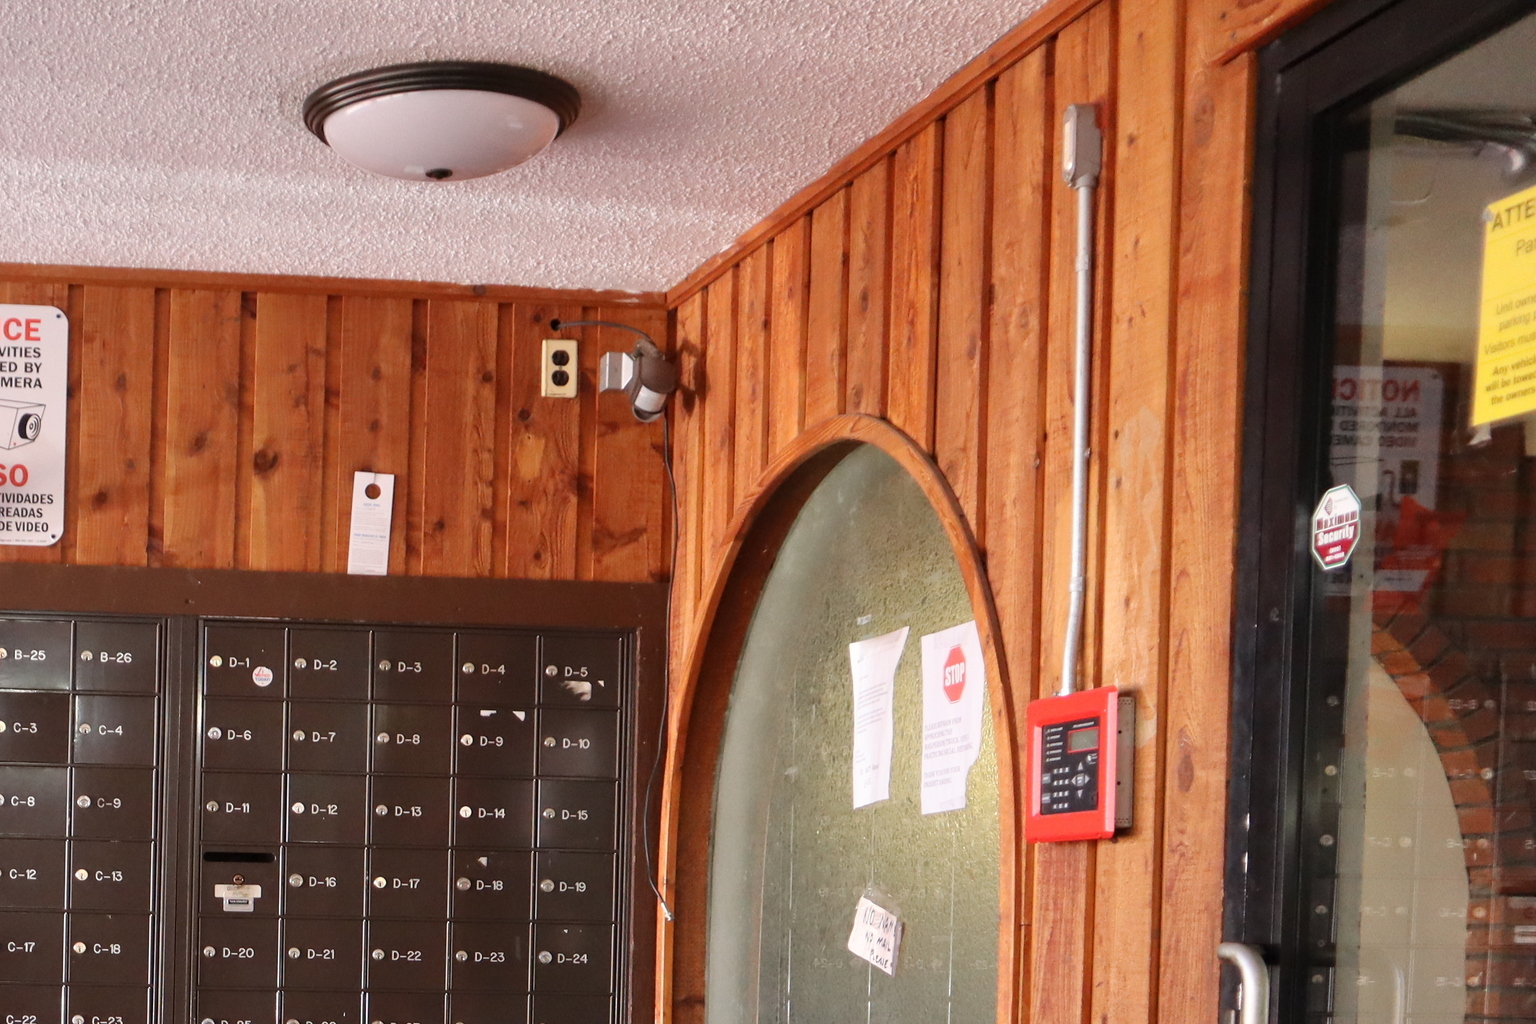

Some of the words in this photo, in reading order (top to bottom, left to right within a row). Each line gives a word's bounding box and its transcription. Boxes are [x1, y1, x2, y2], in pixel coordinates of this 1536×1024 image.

[1492, 197, 1536, 232] ATTE
[1516, 237, 1536, 257] Pa
[24, 362, 42, 373] BY
[15, 521, 49, 533] VIDEO
[1317, 525, 1355, 546] Security
[15, 650, 46, 660] B-25
[101, 652, 131, 663] B-26
[230, 657, 249, 667] D-1
[314, 660, 337, 670] D-2
[398, 662, 421, 672] D-3
[482, 664, 505, 674] D-4
[565, 667, 588, 677] D-5
[944, 662, 964, 686] STOP
[14, 723, 37, 733] C-3
[99, 725, 122, 735] C-4
[228, 730, 251, 740] D-6
[313, 732, 335, 742] D-7
[397, 734, 420, 744] D-8
[480, 736, 503, 746] D-9
[563, 738, 590, 749] D-10
[11, 796, 35, 806] C-8
[98, 798, 121, 808] C-9
[226, 803, 249, 812] D-11
[312, 804, 337, 814] D-12
[395, 806, 421, 816] D-13
[479, 808, 505, 818] D-14
[562, 810, 588, 820] D-15
[10, 869, 36, 879] C-12
[96, 871, 122, 881] C-13
[310, 877, 336, 887] D-16
[394, 879, 419, 888] D-17
[477, 880, 503, 890] D-18
[560, 882, 586, 892] D-19
[8, 942, 35, 952] C-17
[94, 944, 120, 954] C-18
[223, 948, 254, 958] D-20
[308, 949, 334, 959] D-21
[392, 951, 421, 961] D-22
[475, 952, 505, 962] D-23
[558, 954, 587, 963] D-24
[6, 1015, 37, 1024] C-22
